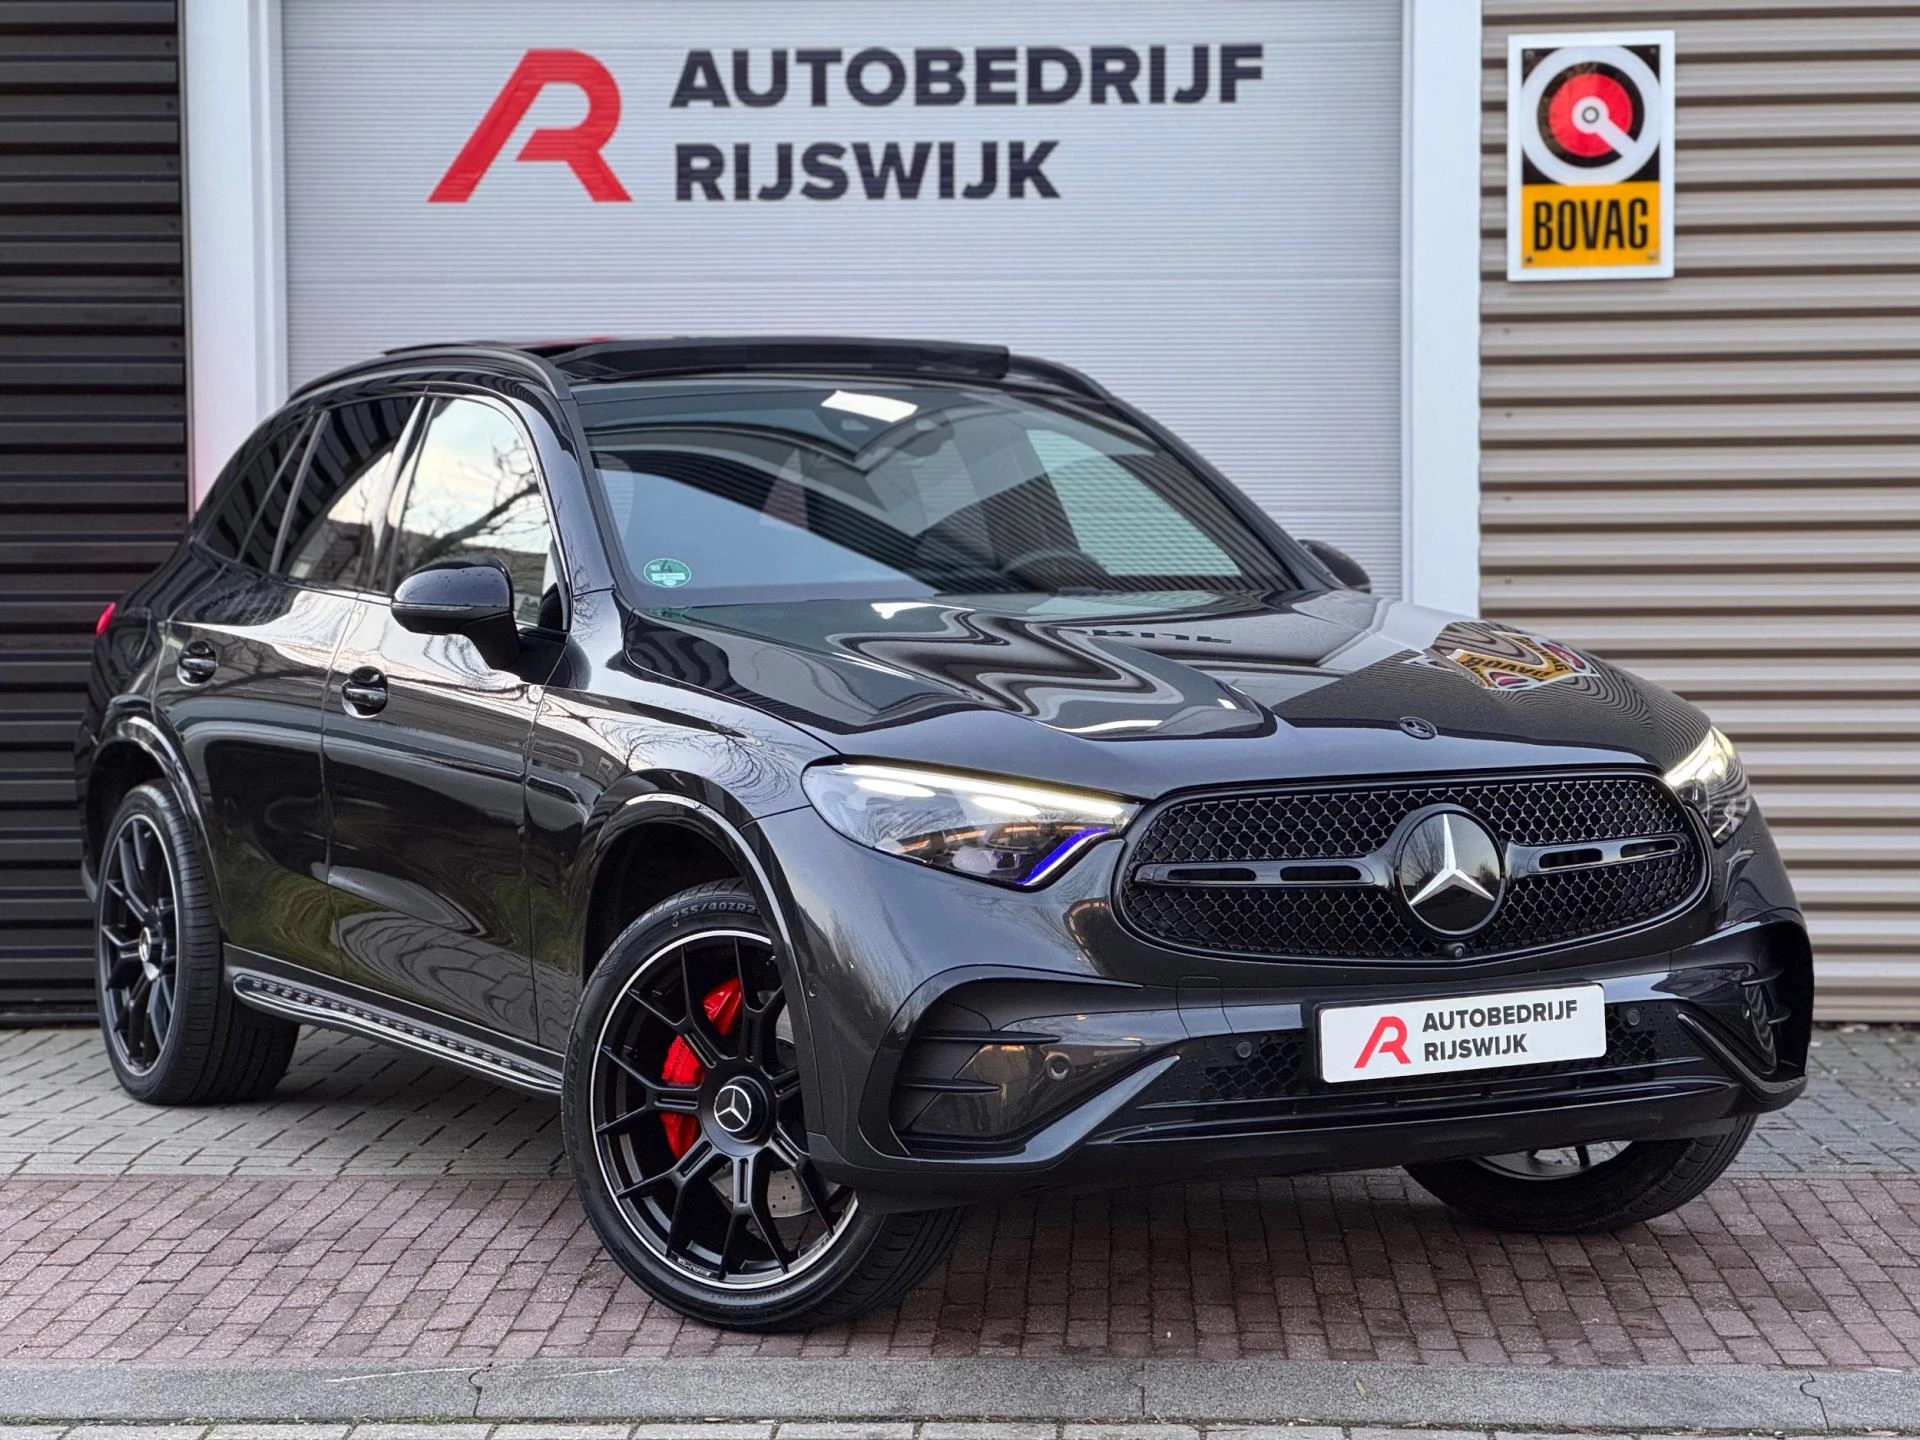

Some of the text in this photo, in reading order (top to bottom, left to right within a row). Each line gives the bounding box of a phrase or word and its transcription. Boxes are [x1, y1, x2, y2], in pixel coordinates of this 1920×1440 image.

[671, 44, 1263, 108] AUTOBEDRIJF
[676, 140, 1060, 202] RIJSWIJK
[1533, 197, 1648, 252] BOVAG
[672, 901, 759, 920] 255/40ZR2
[1422, 999, 1578, 1033] AUTOBEDRIJF
[1424, 1033, 1528, 1063] RIJSWIJK
